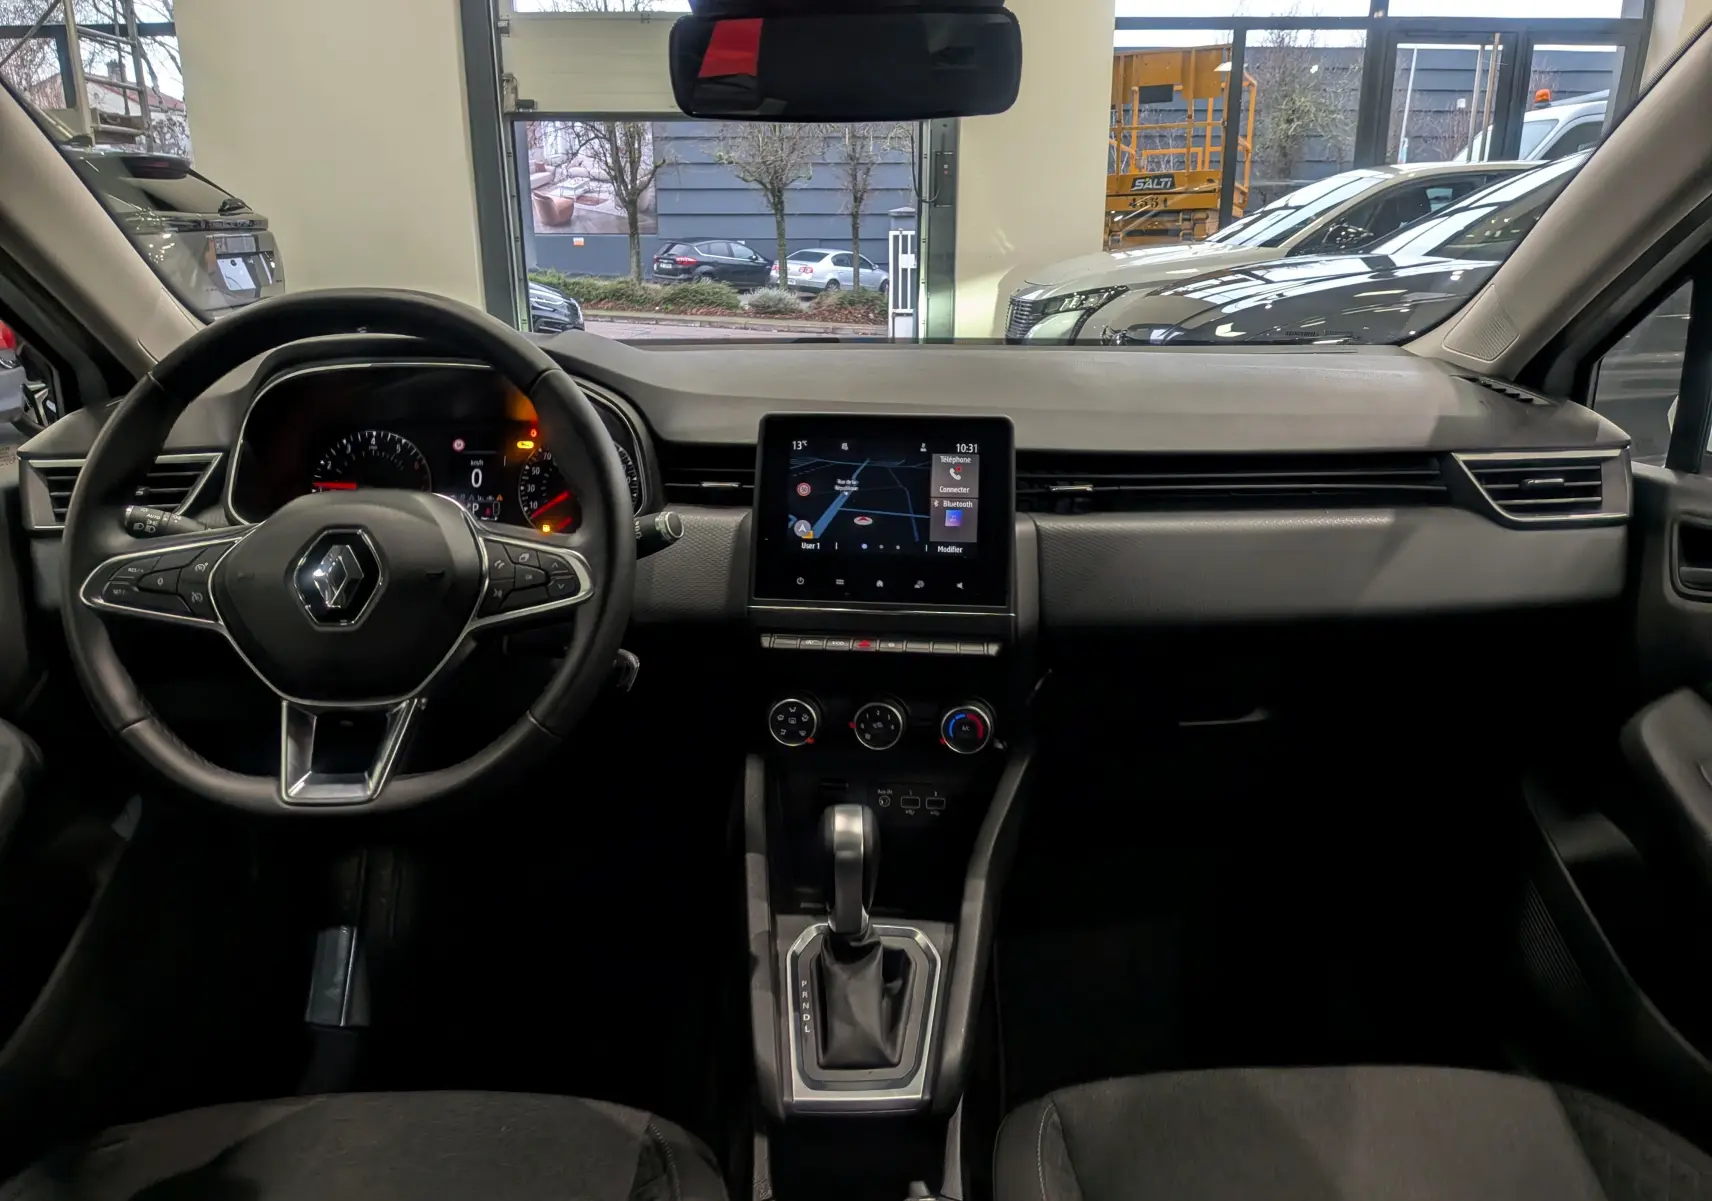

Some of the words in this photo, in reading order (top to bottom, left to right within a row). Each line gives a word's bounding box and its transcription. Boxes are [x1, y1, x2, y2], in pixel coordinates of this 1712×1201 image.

[1131, 177, 1172, 190] SALTI
[956, 443, 978, 453] 10:31
[940, 455, 972, 465] Téléphone
[471, 468, 483, 488] 0
[939, 485, 970, 493] Connecter
[529, 501, 538, 509] 10
[943, 499, 973, 508] Bluetooth
[937, 545, 963, 553] Modifier
[803, 1013, 810, 1021] D
[804, 1025, 811, 1033] L
